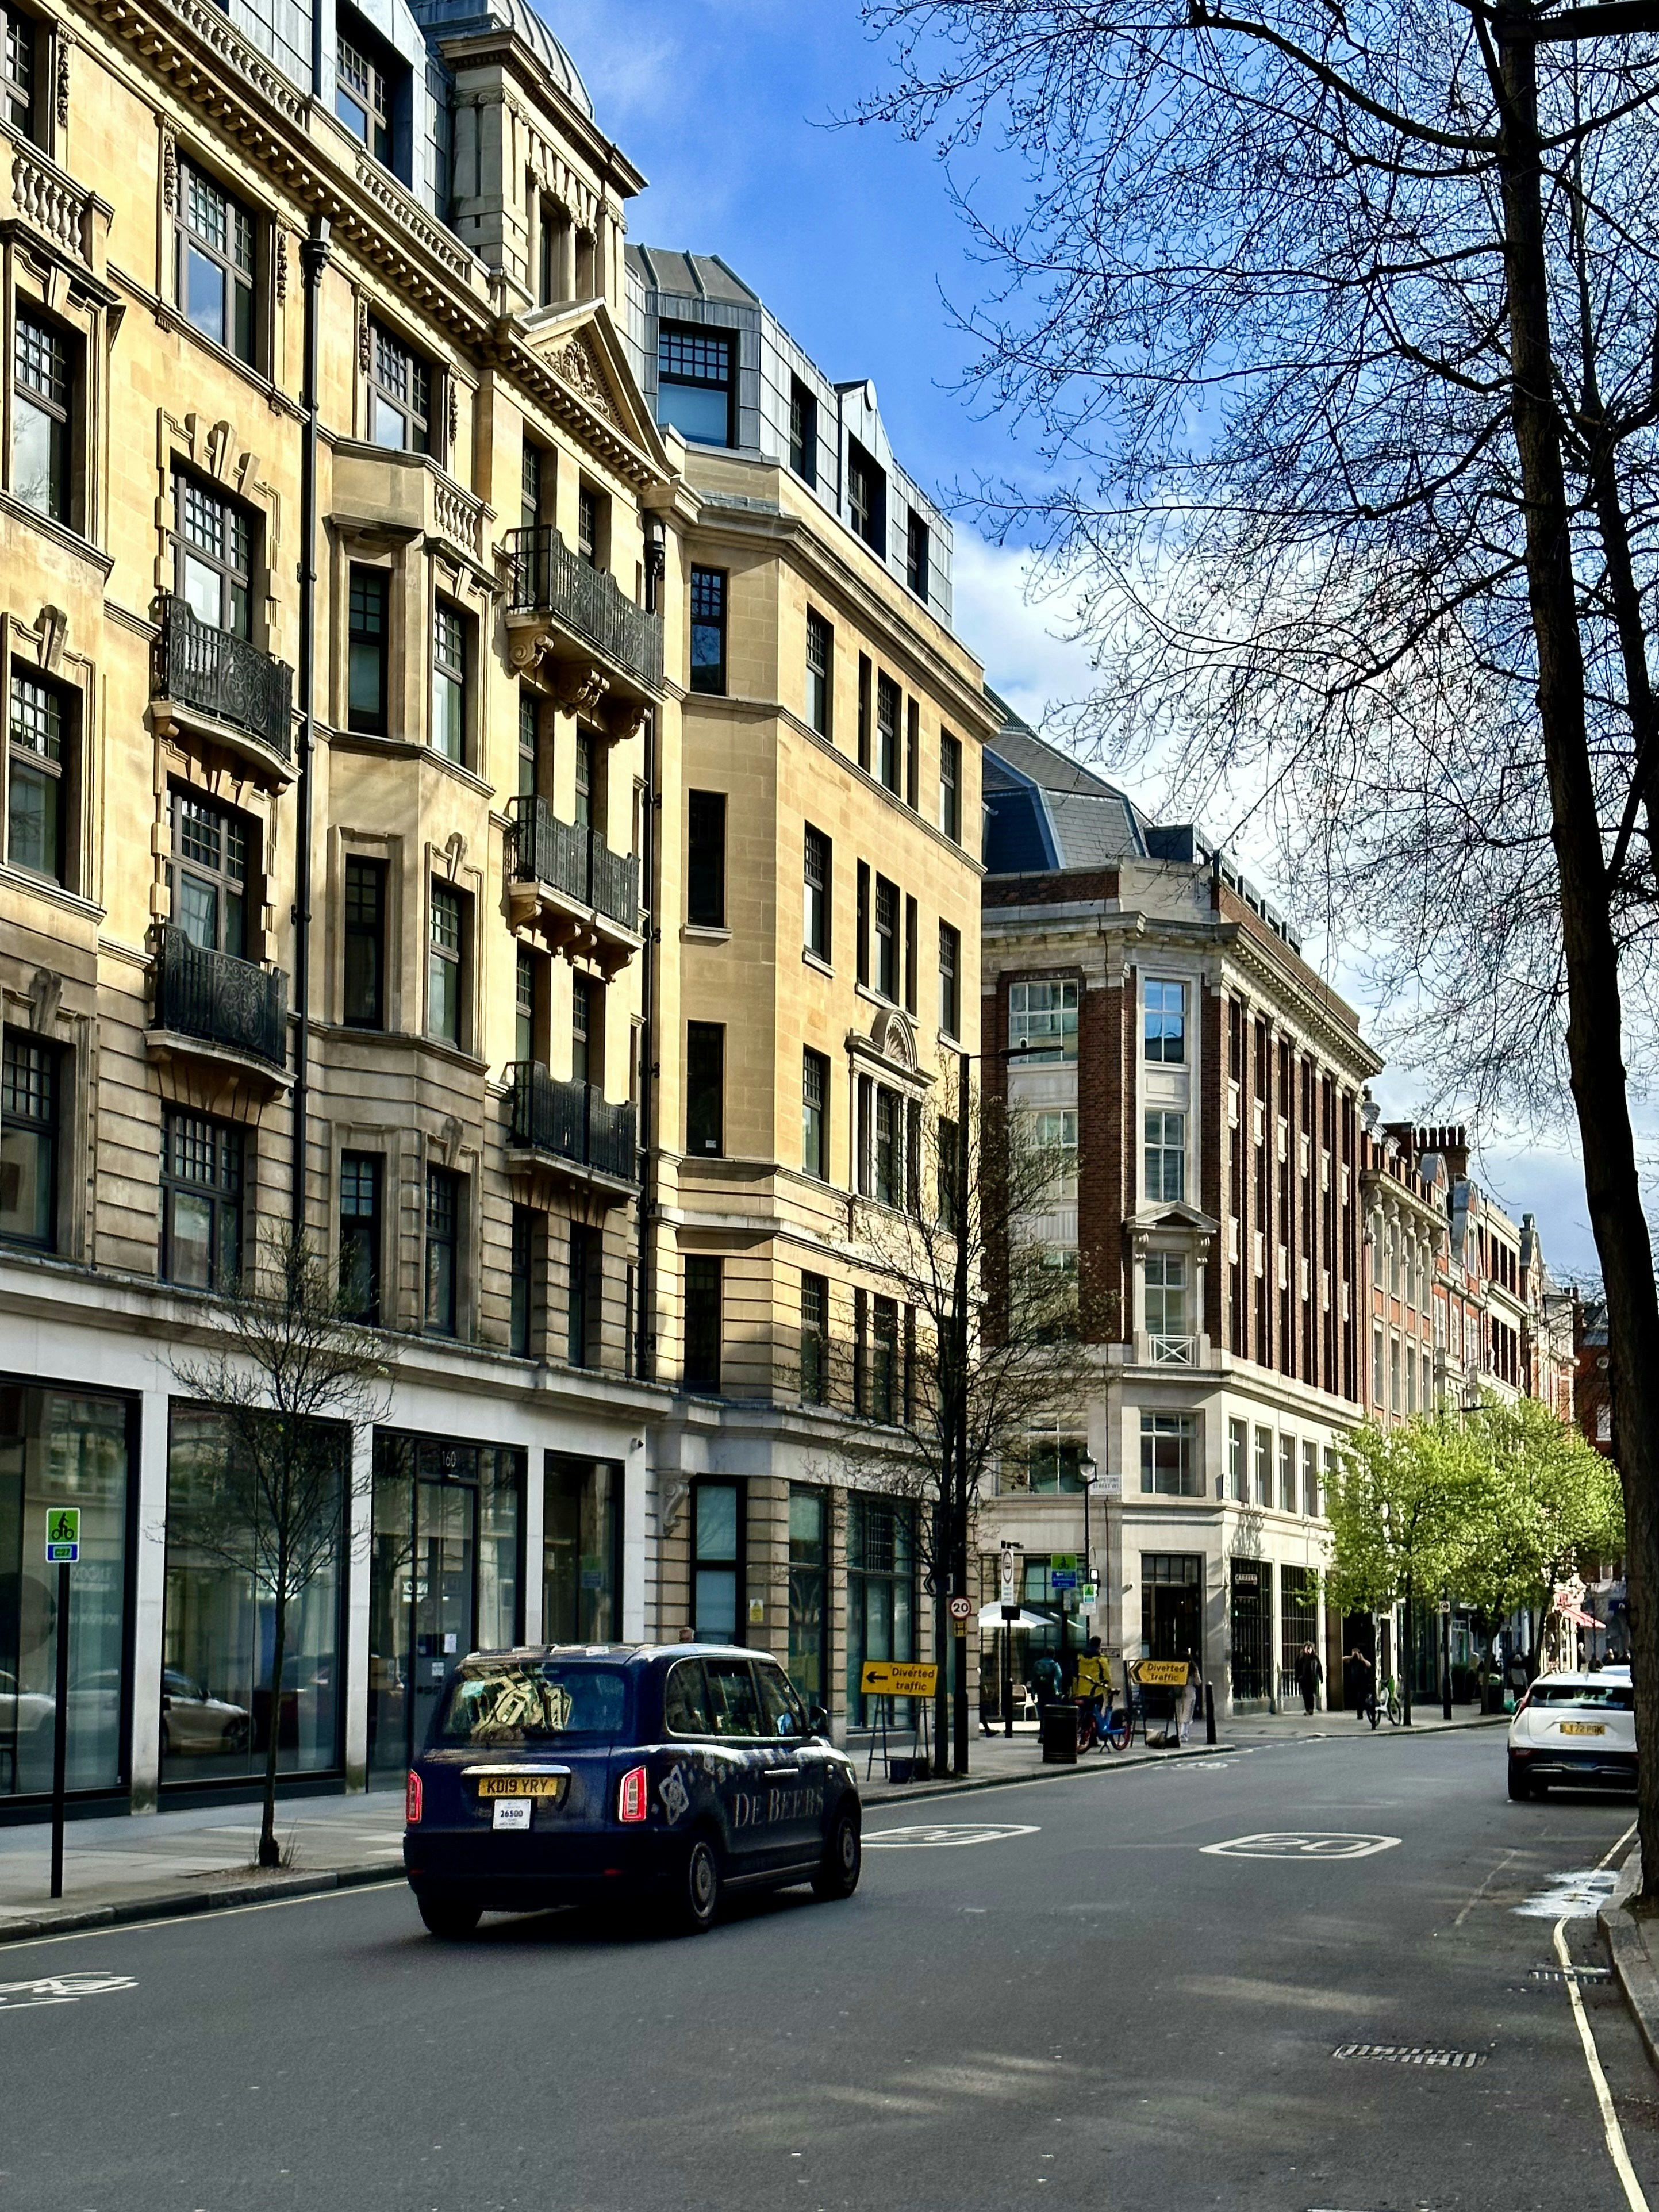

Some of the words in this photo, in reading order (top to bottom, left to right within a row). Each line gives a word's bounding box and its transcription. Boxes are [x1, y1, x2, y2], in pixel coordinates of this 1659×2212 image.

[442, 1451, 456, 1468] 160
[953, 1603, 969, 1612] 20
[955, 1622, 966, 1635] H
[892, 1667, 935, 1678] Diverted
[1147, 1663, 1185, 1673] Diverted
[1151, 1673, 1178, 1682] traffic
[896, 1681, 927, 1692] traffic
[487, 1779, 517, 1793] KD19
[521, 1779, 547, 1793] YRY
[1234, 1837, 1372, 1852] 20
